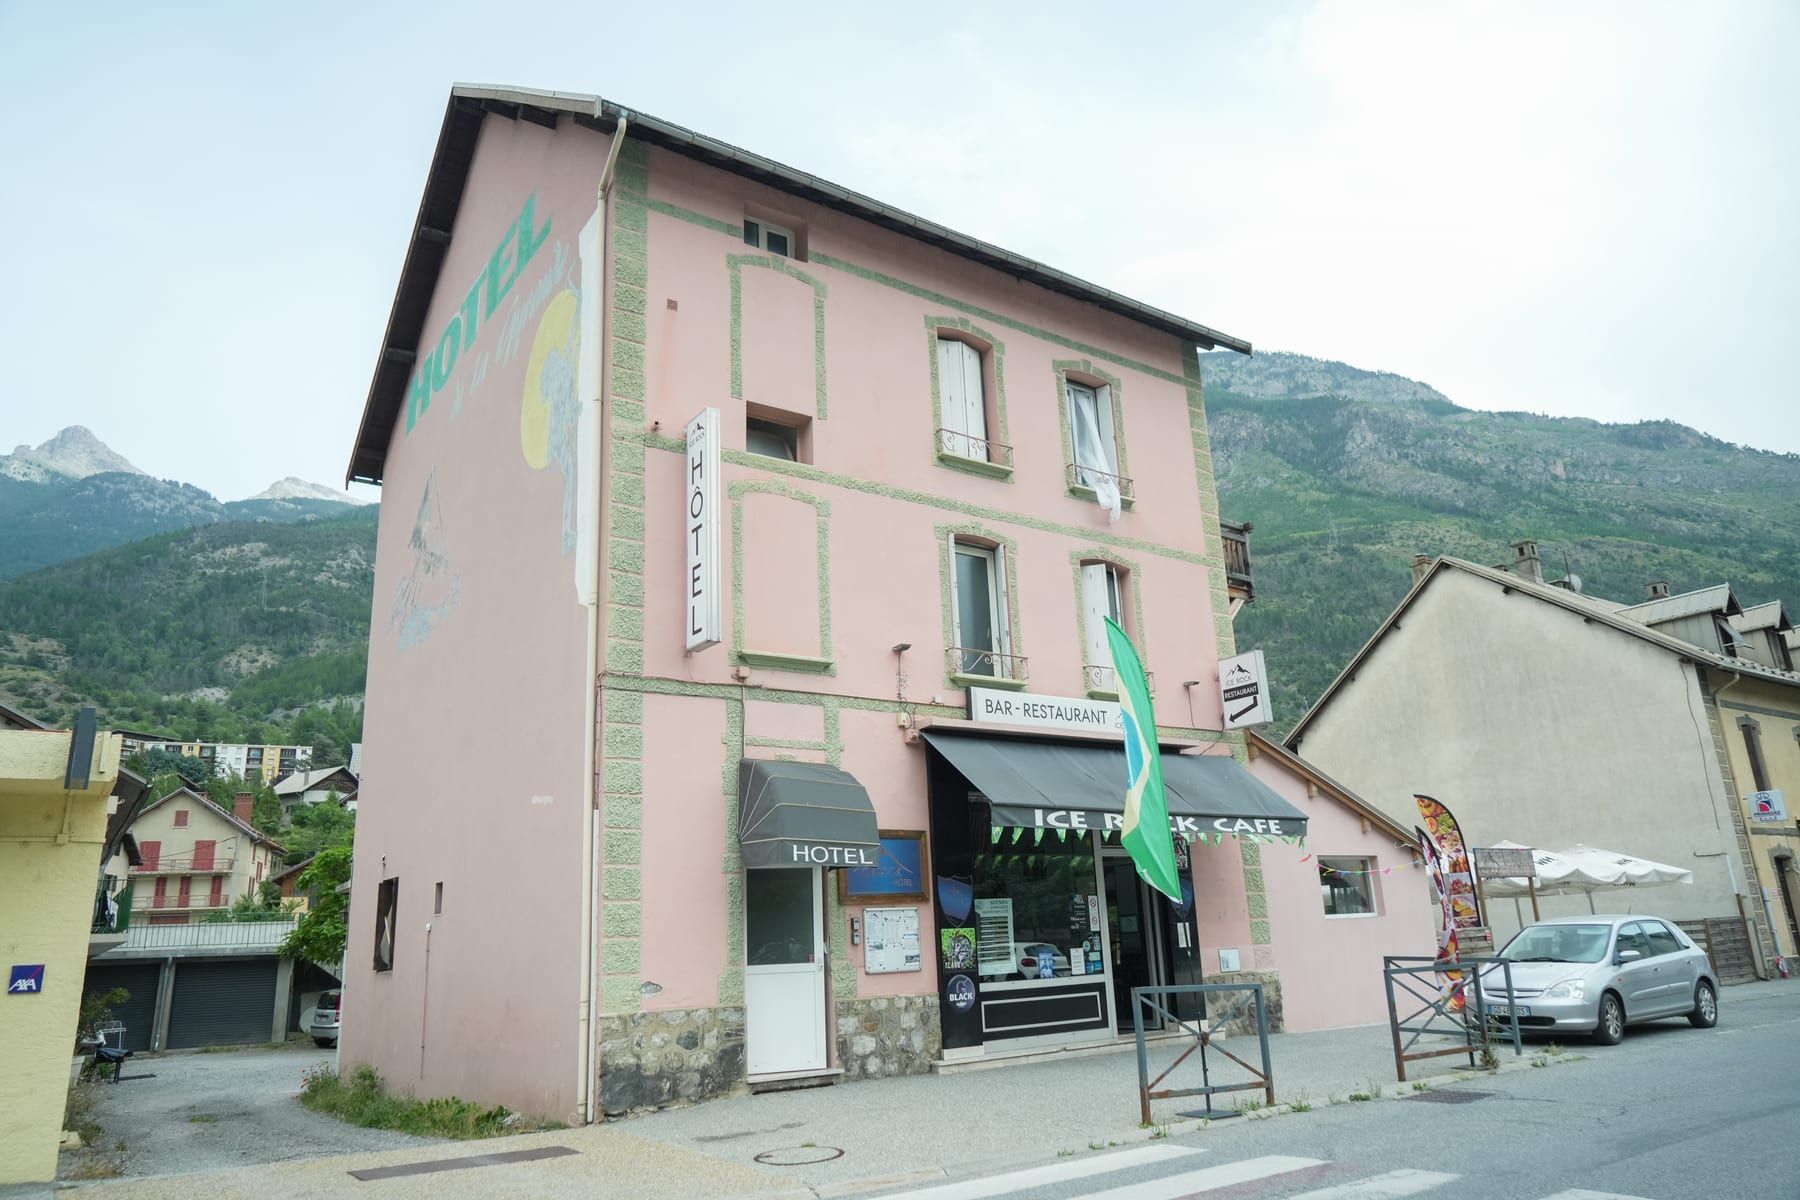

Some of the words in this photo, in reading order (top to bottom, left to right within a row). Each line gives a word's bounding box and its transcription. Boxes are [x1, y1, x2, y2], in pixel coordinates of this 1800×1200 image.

[406, 189, 554, 436] HOTEL
[690, 449, 704, 636] HÔTEL
[1224, 685, 1258, 699] RESTAURANT
[1034, 808, 1087, 828] ICE
[1213, 816, 1283, 835] CAFE
[792, 844, 874, 865] HOTEL
[9, 978, 37, 991] AXA
[949, 992, 973, 1002] BLACK
